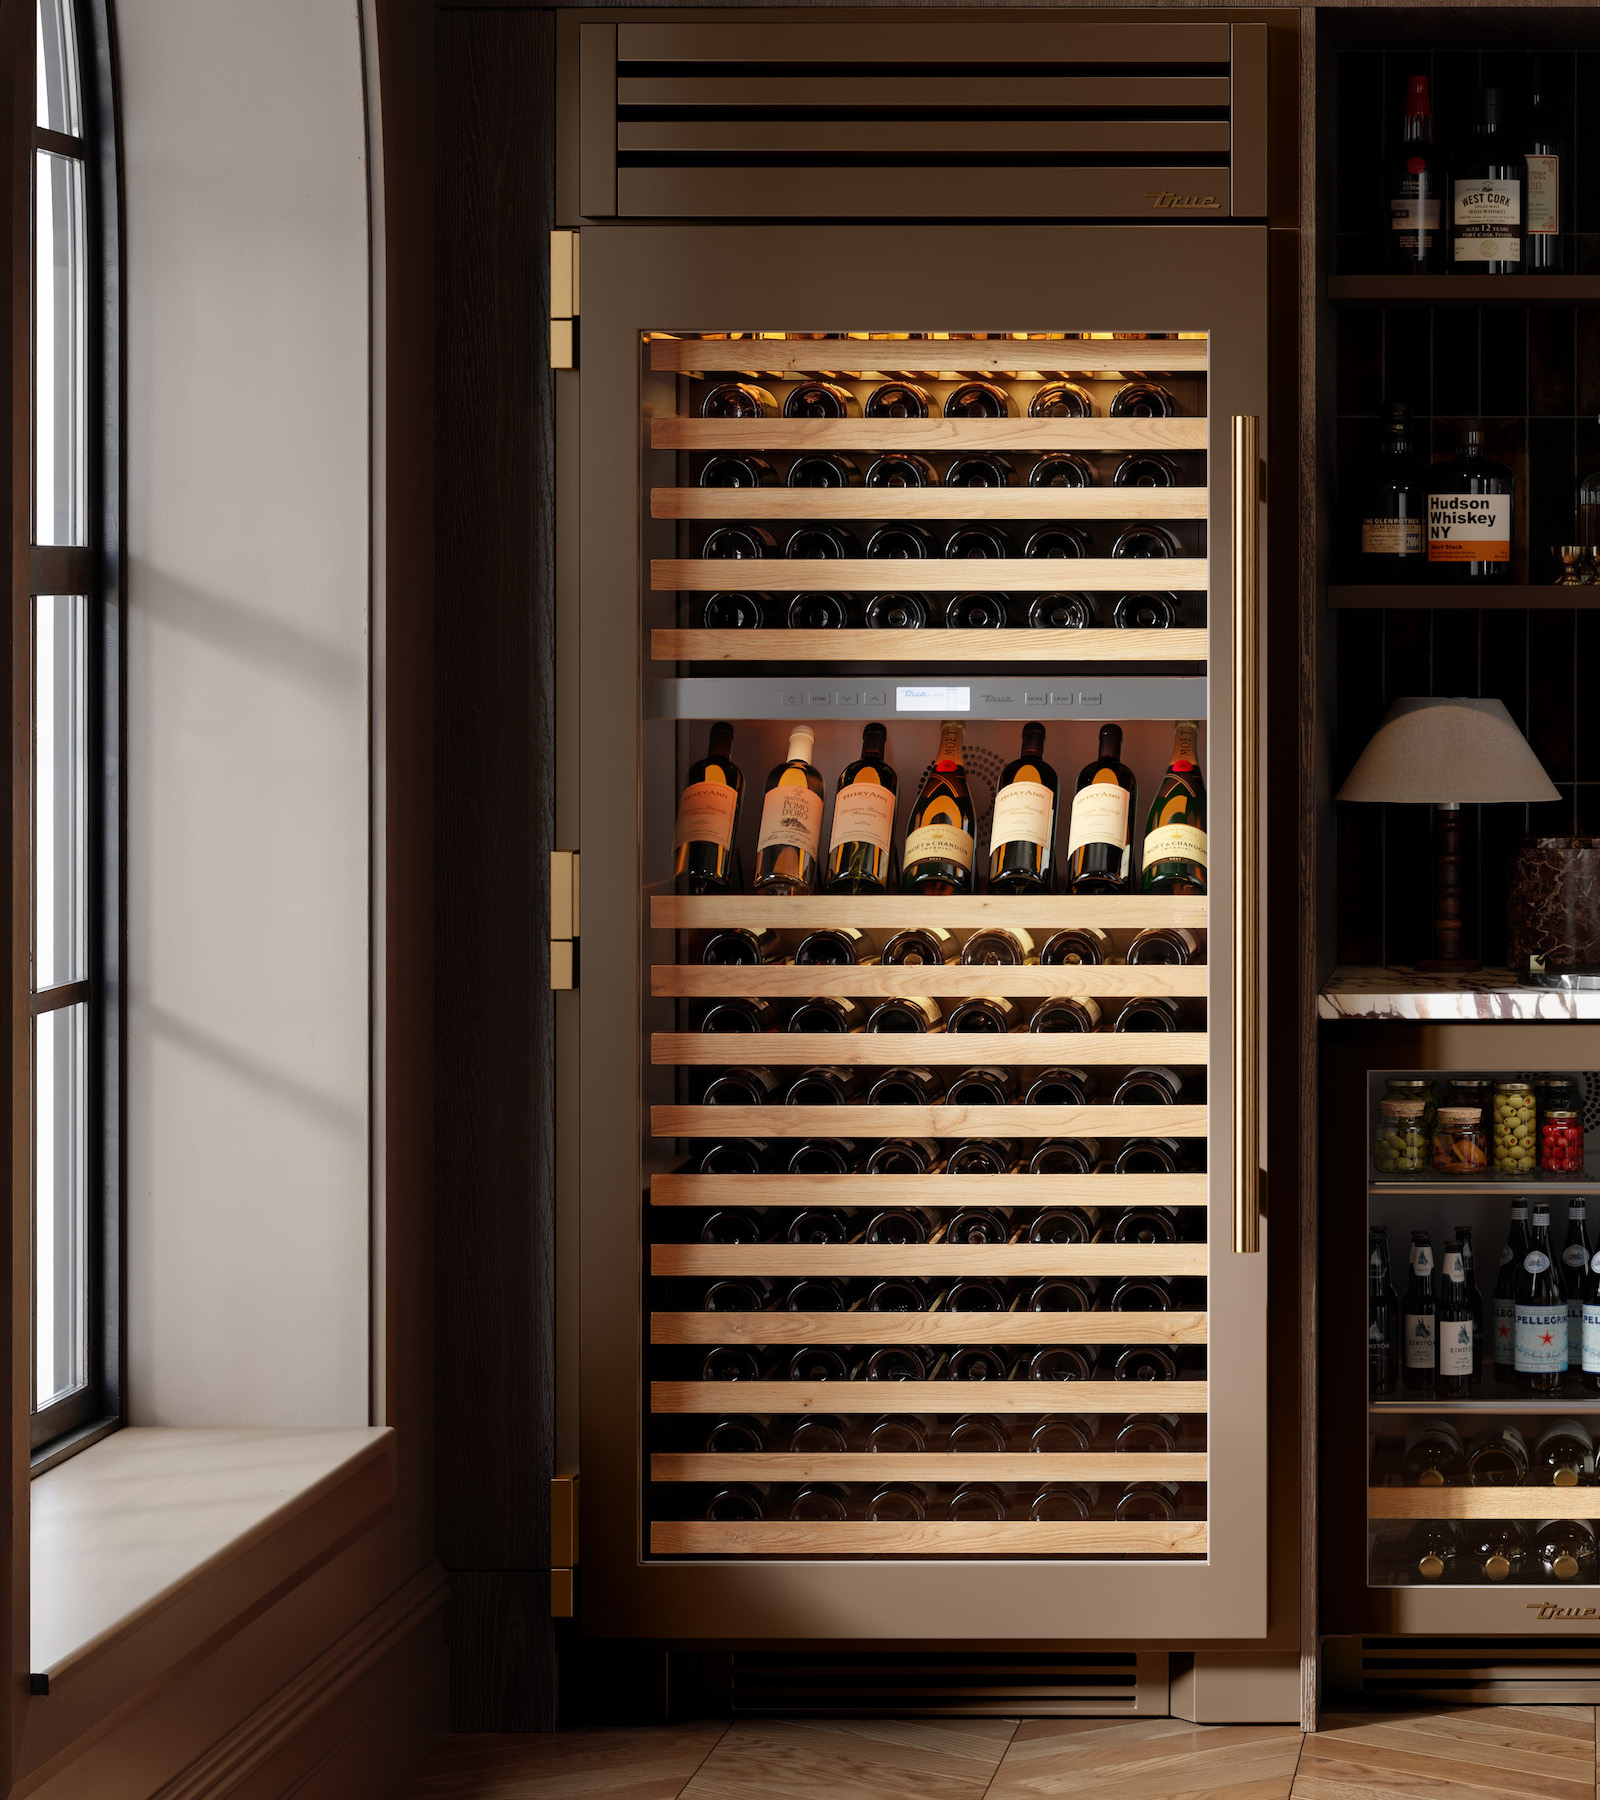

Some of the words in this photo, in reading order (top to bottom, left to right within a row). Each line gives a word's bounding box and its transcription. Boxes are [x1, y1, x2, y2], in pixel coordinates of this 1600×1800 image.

[1461, 193, 1485, 207] WEST
[1487, 193, 1511, 207] CORK
[1481, 224, 1491, 232] 12
[1431, 497, 1490, 510] Hudson
[1431, 511, 1497, 527] Whiskey
[1431, 526, 1451, 539] NY
[783, 800, 809, 813] POMO
[784, 796, 810, 806] TRATTORIA
[782, 808, 808, 821] D'ORO
[932, 841, 969, 856] CHANDON
